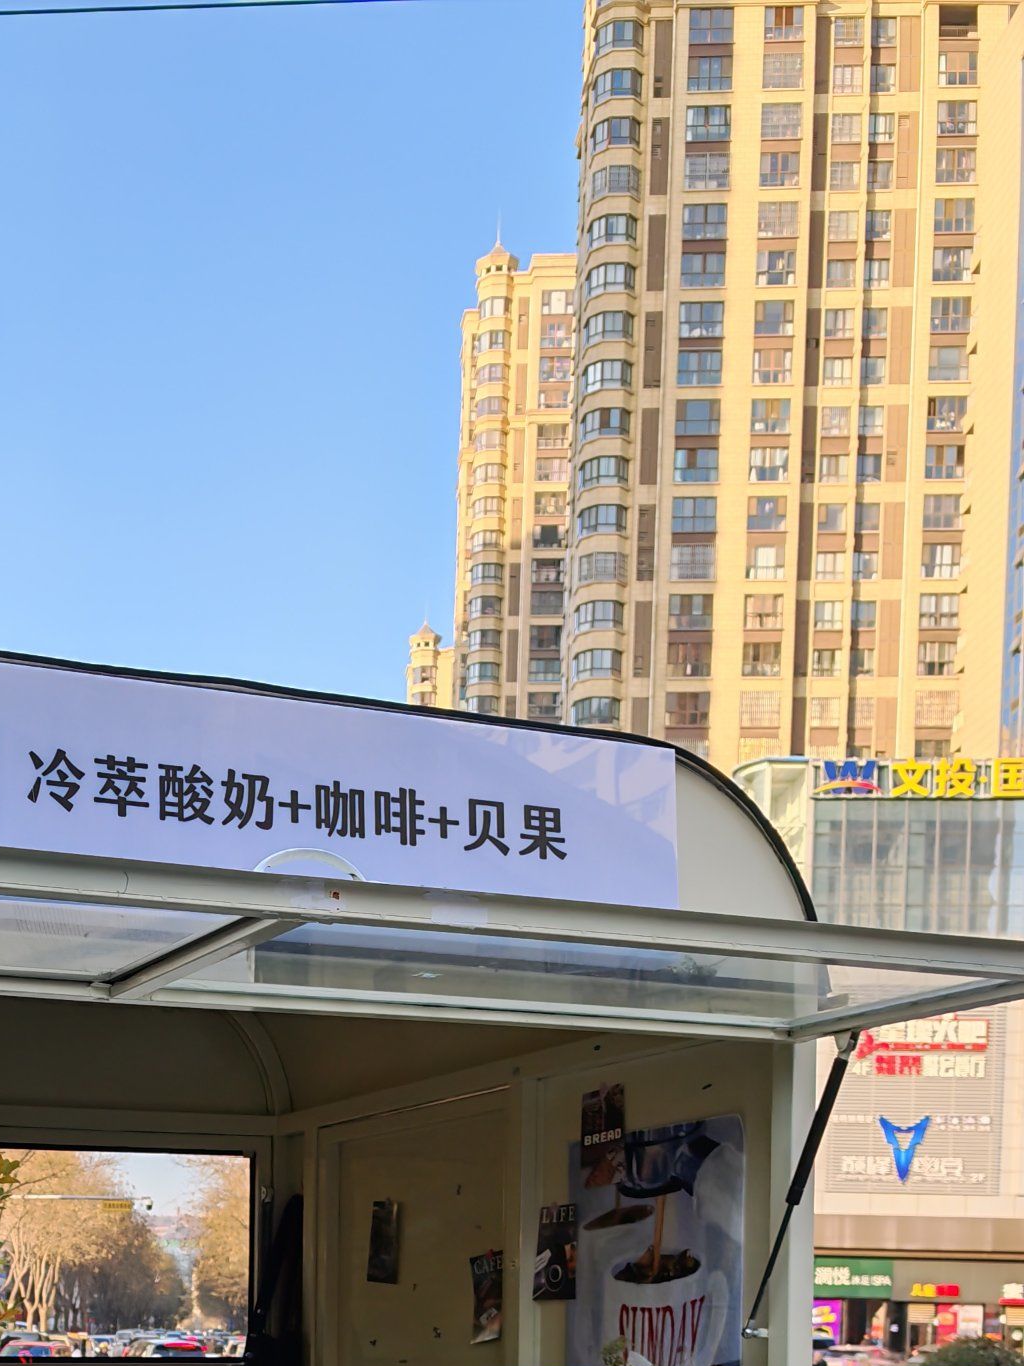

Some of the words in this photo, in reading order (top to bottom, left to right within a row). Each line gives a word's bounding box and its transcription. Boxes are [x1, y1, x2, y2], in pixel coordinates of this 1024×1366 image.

[28, 748, 568, 861] 冷萃酸奶+咖啡+贝果
[583, 1128, 622, 1146] BREAD
[542, 1205, 576, 1224] LIFE
[474, 1255, 503, 1275] CAFE
